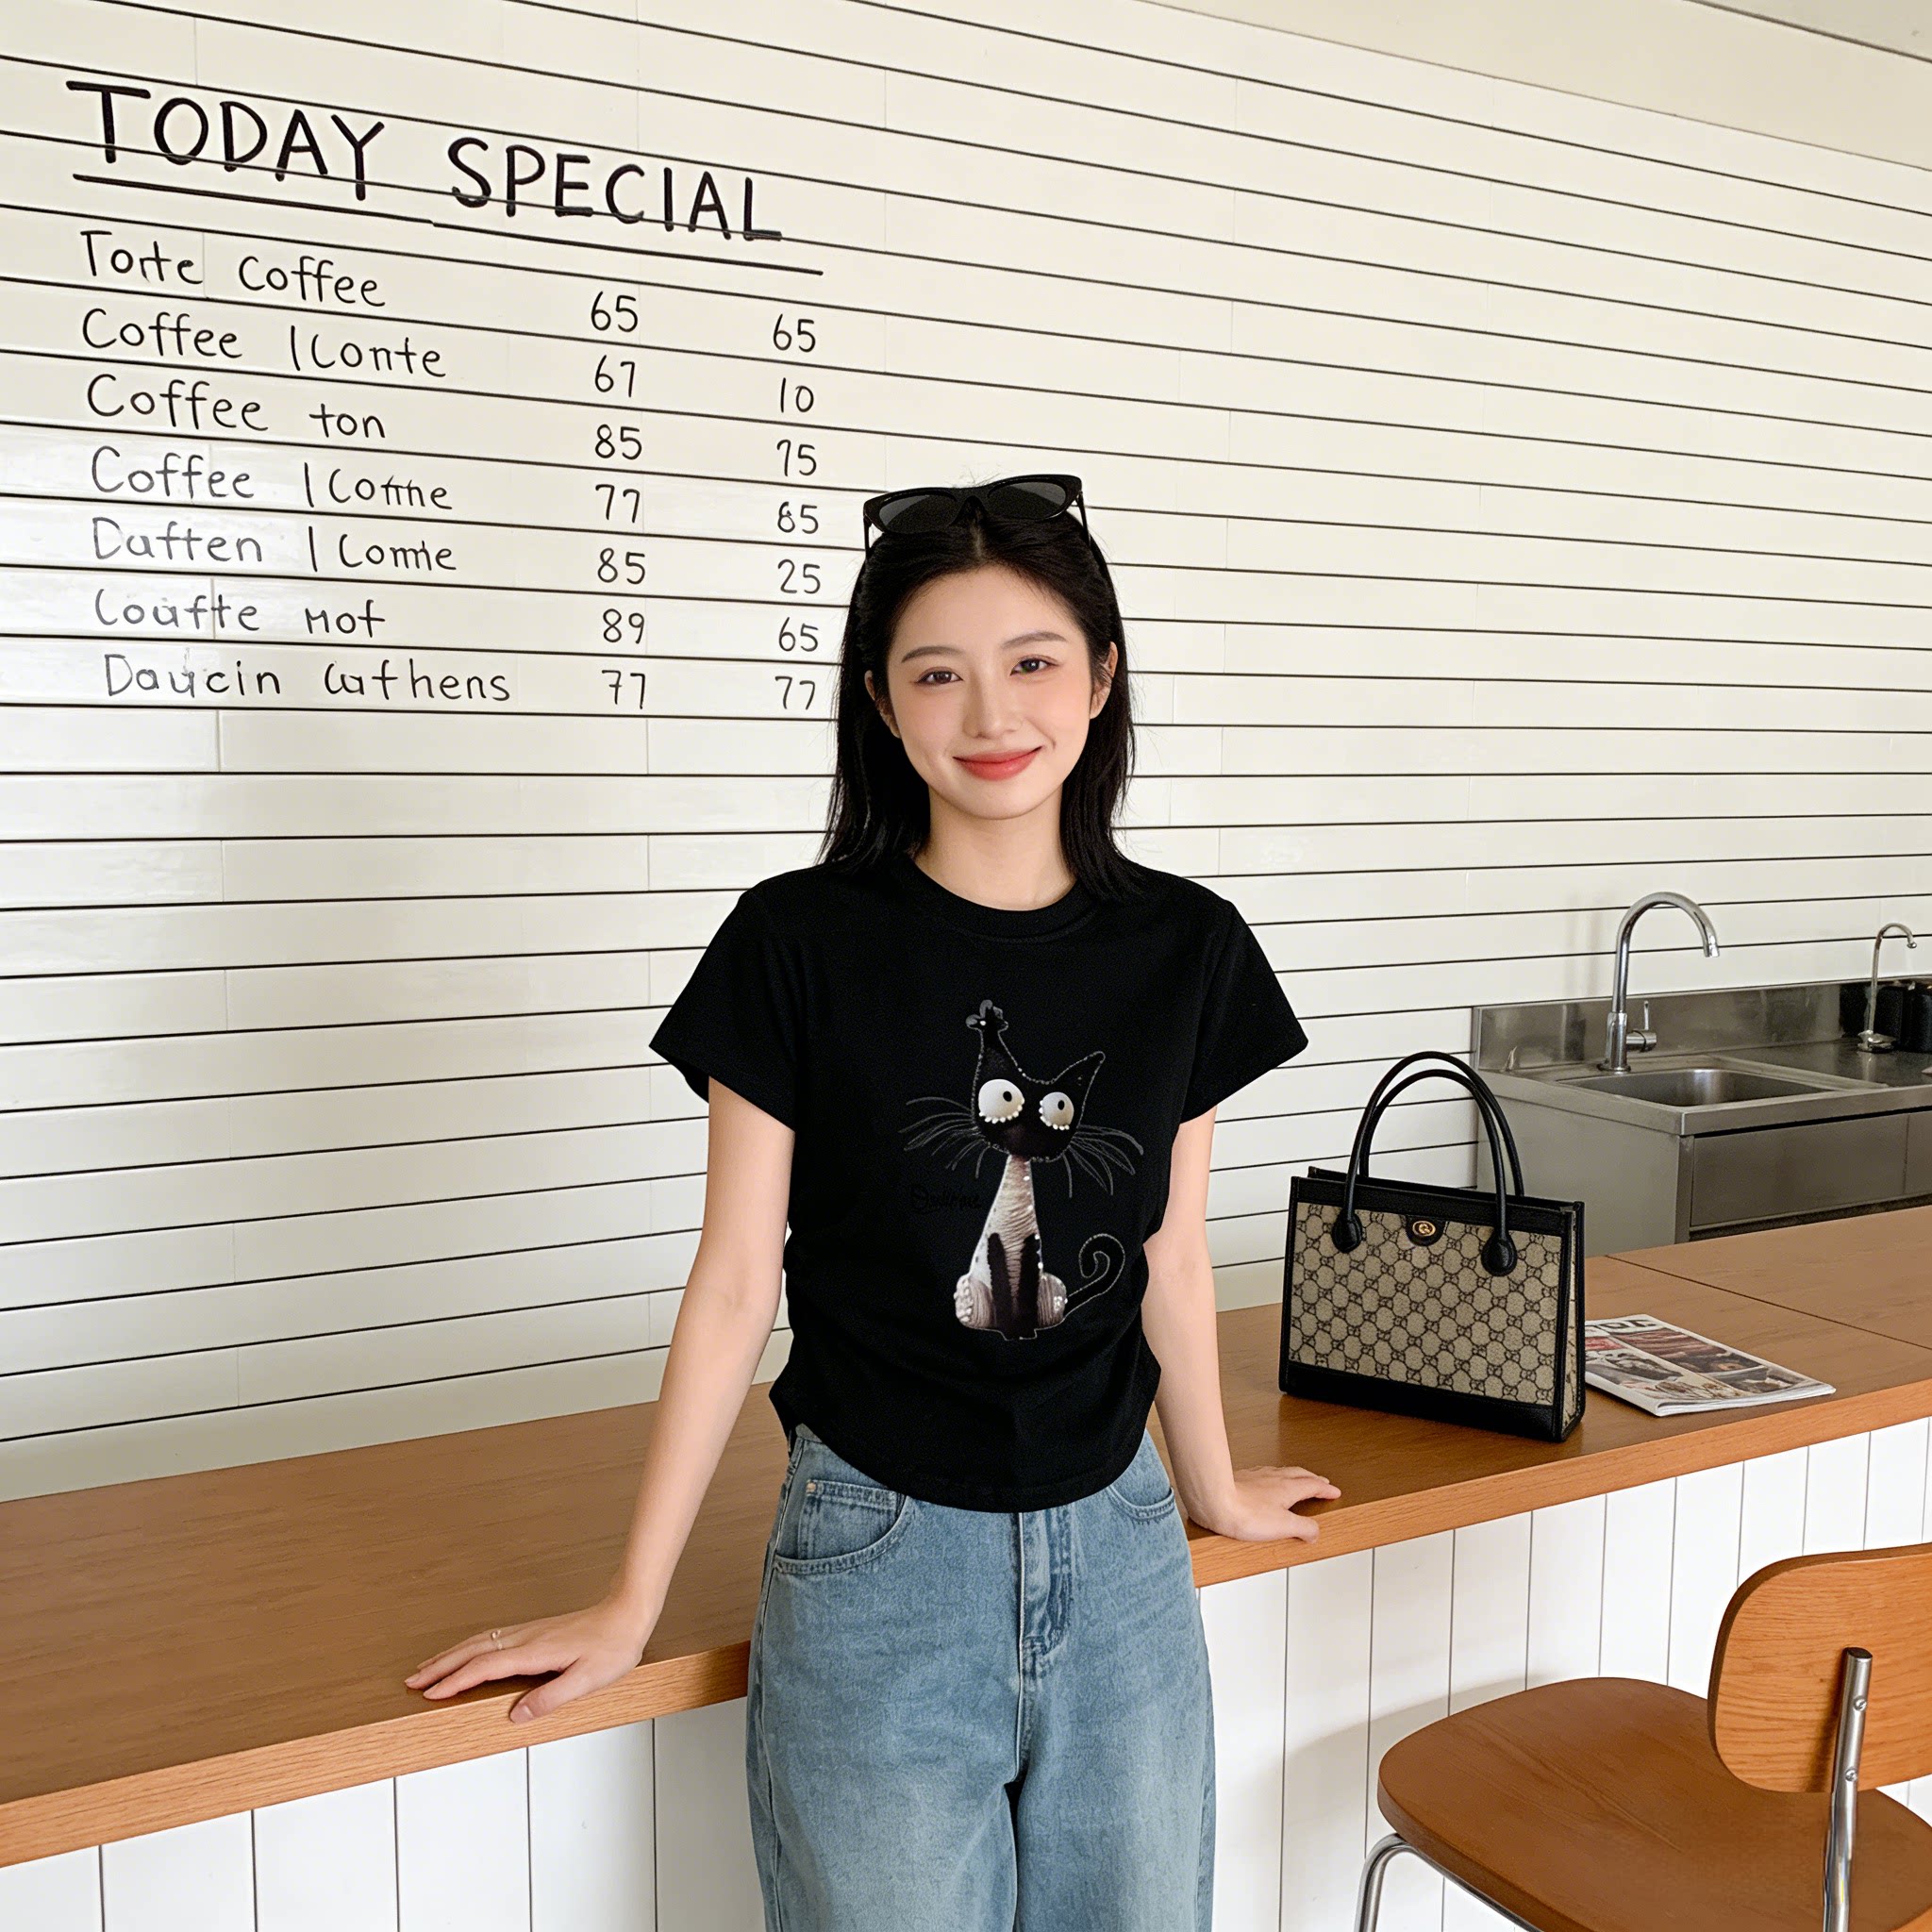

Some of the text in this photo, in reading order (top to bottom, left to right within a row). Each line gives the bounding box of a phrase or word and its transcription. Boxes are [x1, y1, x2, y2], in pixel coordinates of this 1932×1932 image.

[66, 78, 785, 243] TODAY SPECIAL
[238, 255, 387, 308] Coffee
[591, 290, 640, 334] 65
[772, 312, 817, 354] 65
[81, 308, 243, 358] Coffee
[593, 353, 636, 399] 67
[87, 373, 270, 432] Coffee
[308, 402, 387, 440] ton
[594, 423, 643, 461] 85
[92, 445, 255, 499] Coffee
[594, 483, 641, 525] 77
[596, 547, 646, 585] 85
[776, 558, 822, 595] 25
[602, 608, 646, 645] 89
[777, 616, 820, 653] 65
[600, 669, 647, 710] 77
[774, 675, 817, 711] 77
